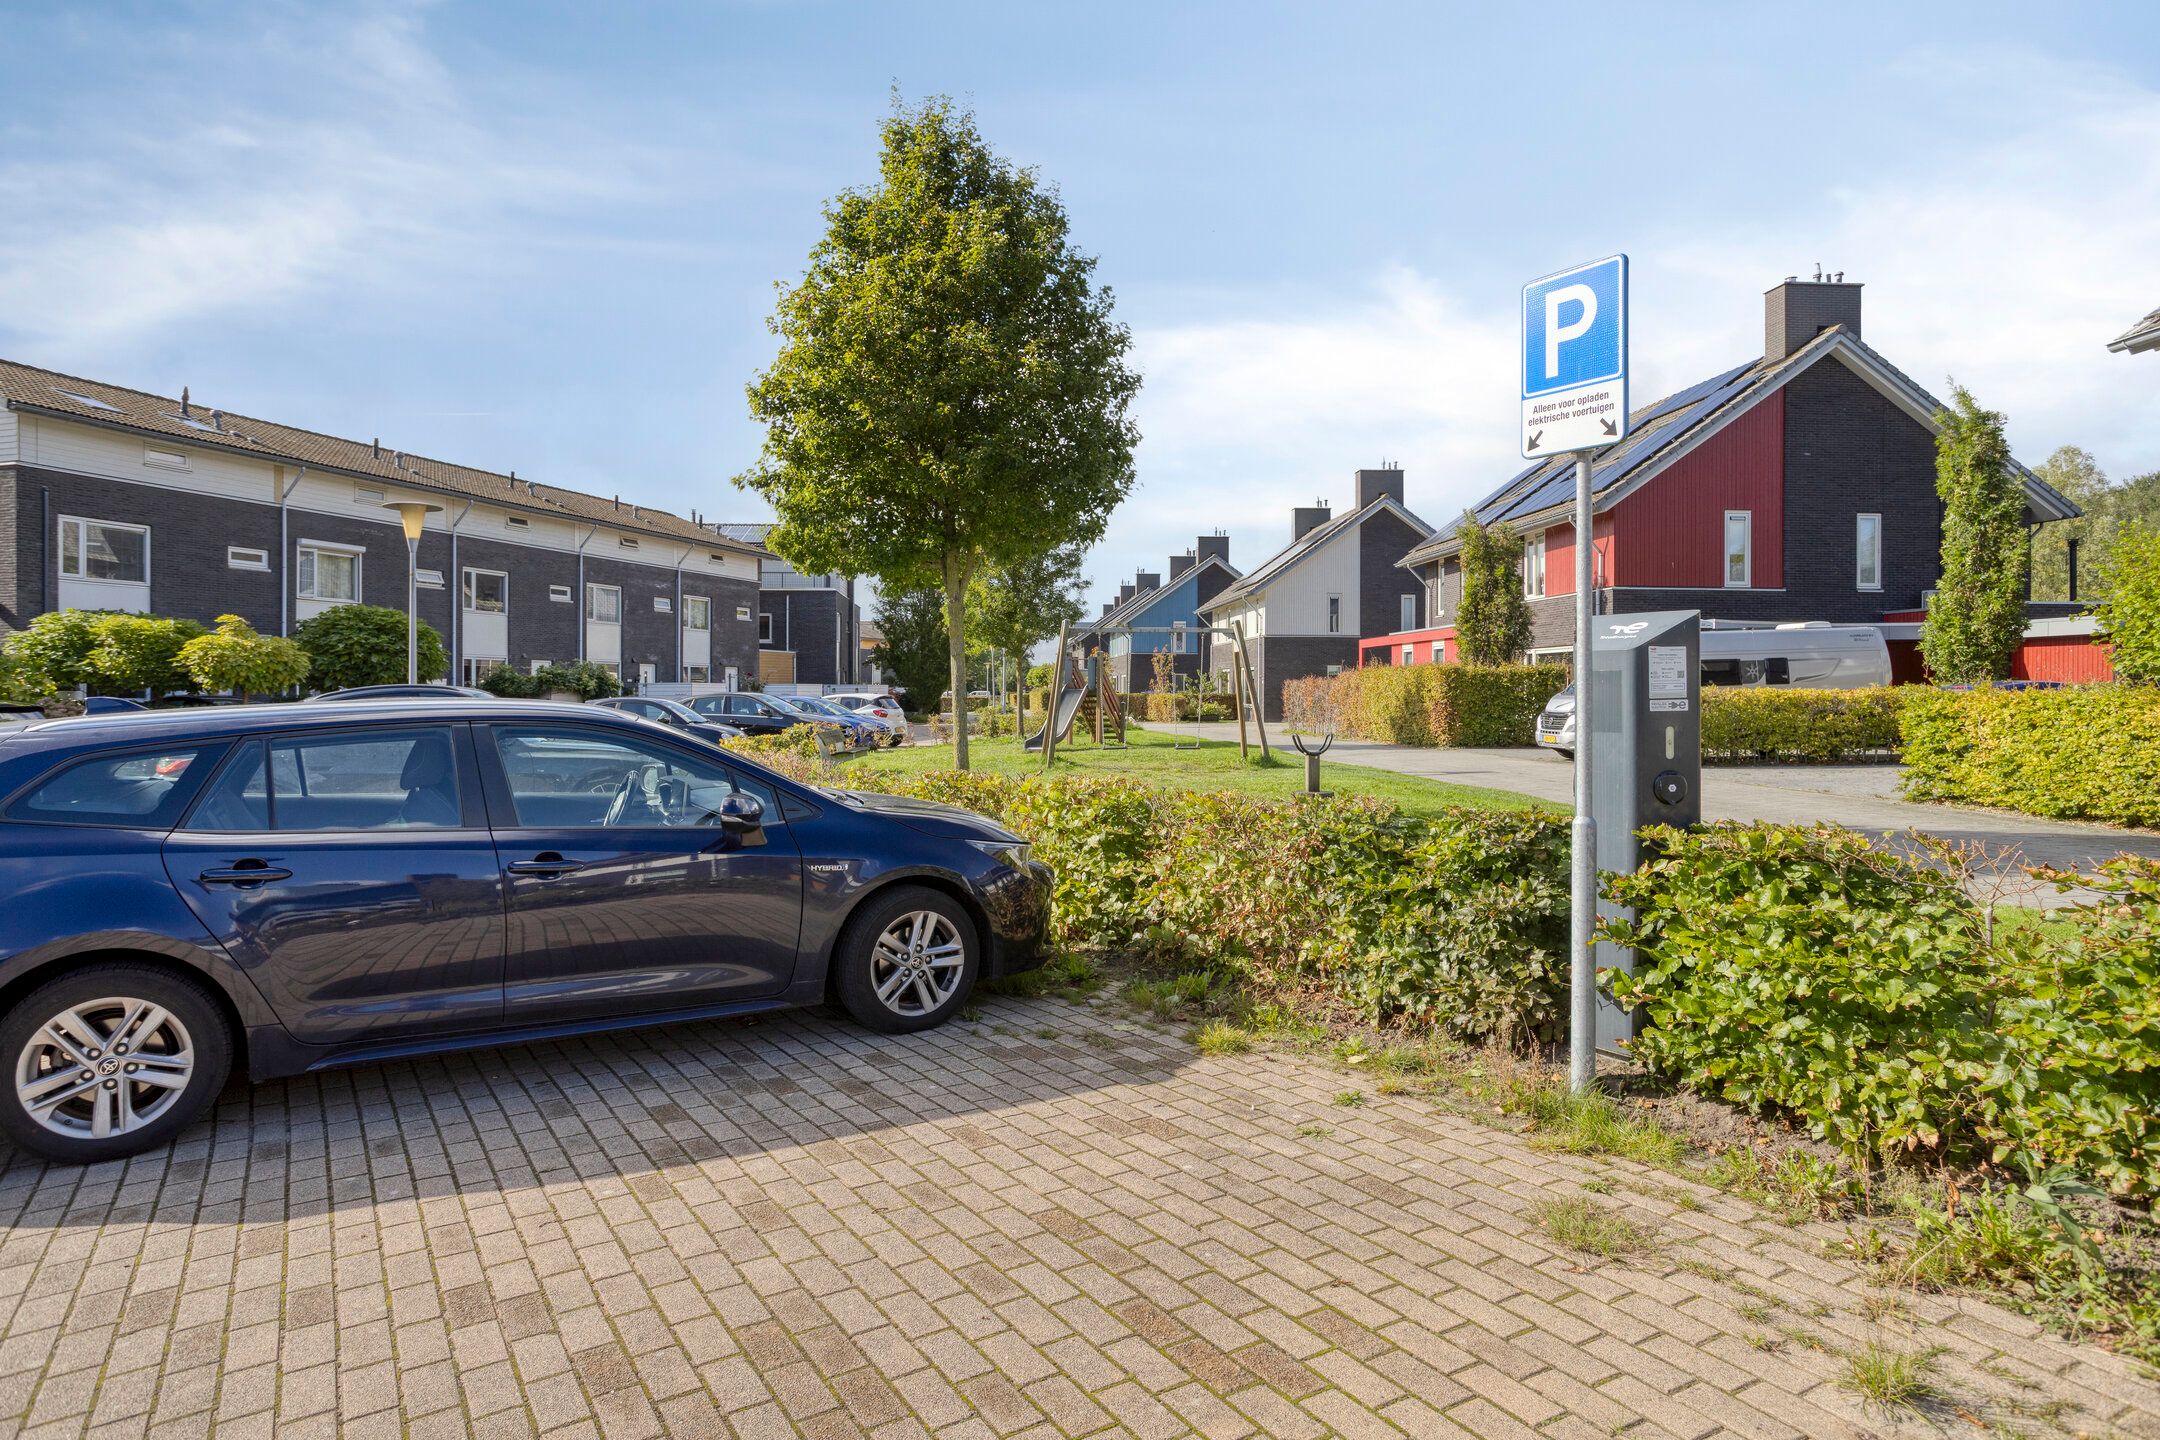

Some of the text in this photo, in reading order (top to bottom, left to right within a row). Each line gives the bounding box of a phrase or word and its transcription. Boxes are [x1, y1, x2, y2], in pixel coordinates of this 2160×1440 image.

[1545, 283, 1598, 379] P
[1528, 402, 1615, 426] elektrische voertuigen
[1533, 391, 1609, 414] Alleen voor opladen
